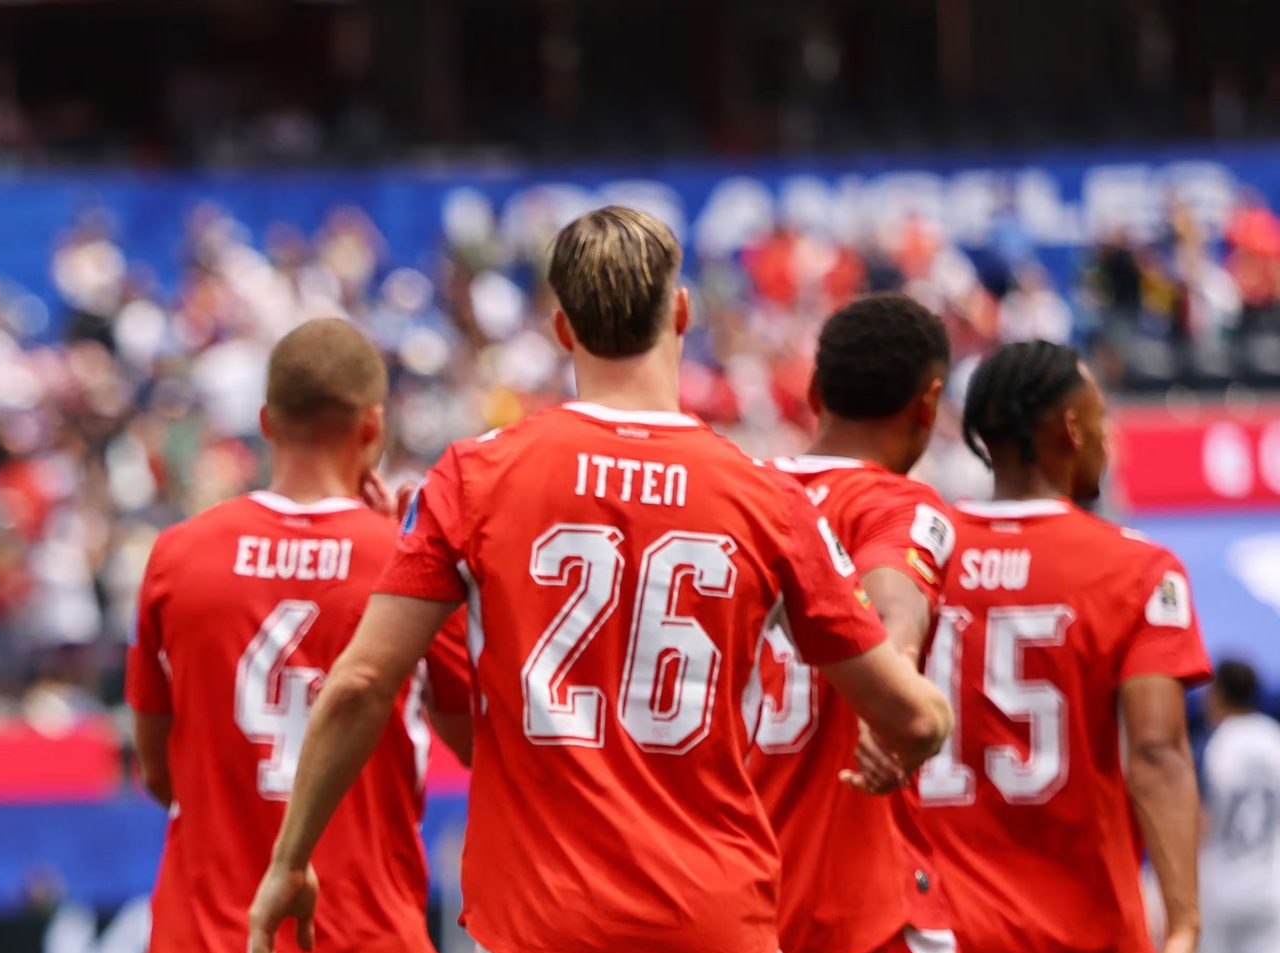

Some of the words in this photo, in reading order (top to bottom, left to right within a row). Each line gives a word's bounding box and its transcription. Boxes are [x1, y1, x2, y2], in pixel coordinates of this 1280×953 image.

[575, 453, 687, 507] ITTEN
[960, 548, 1031, 591] SOW
[234, 599, 327, 802] 4
[521, 523, 738, 755] 26
[920, 604, 1076, 806] 15
